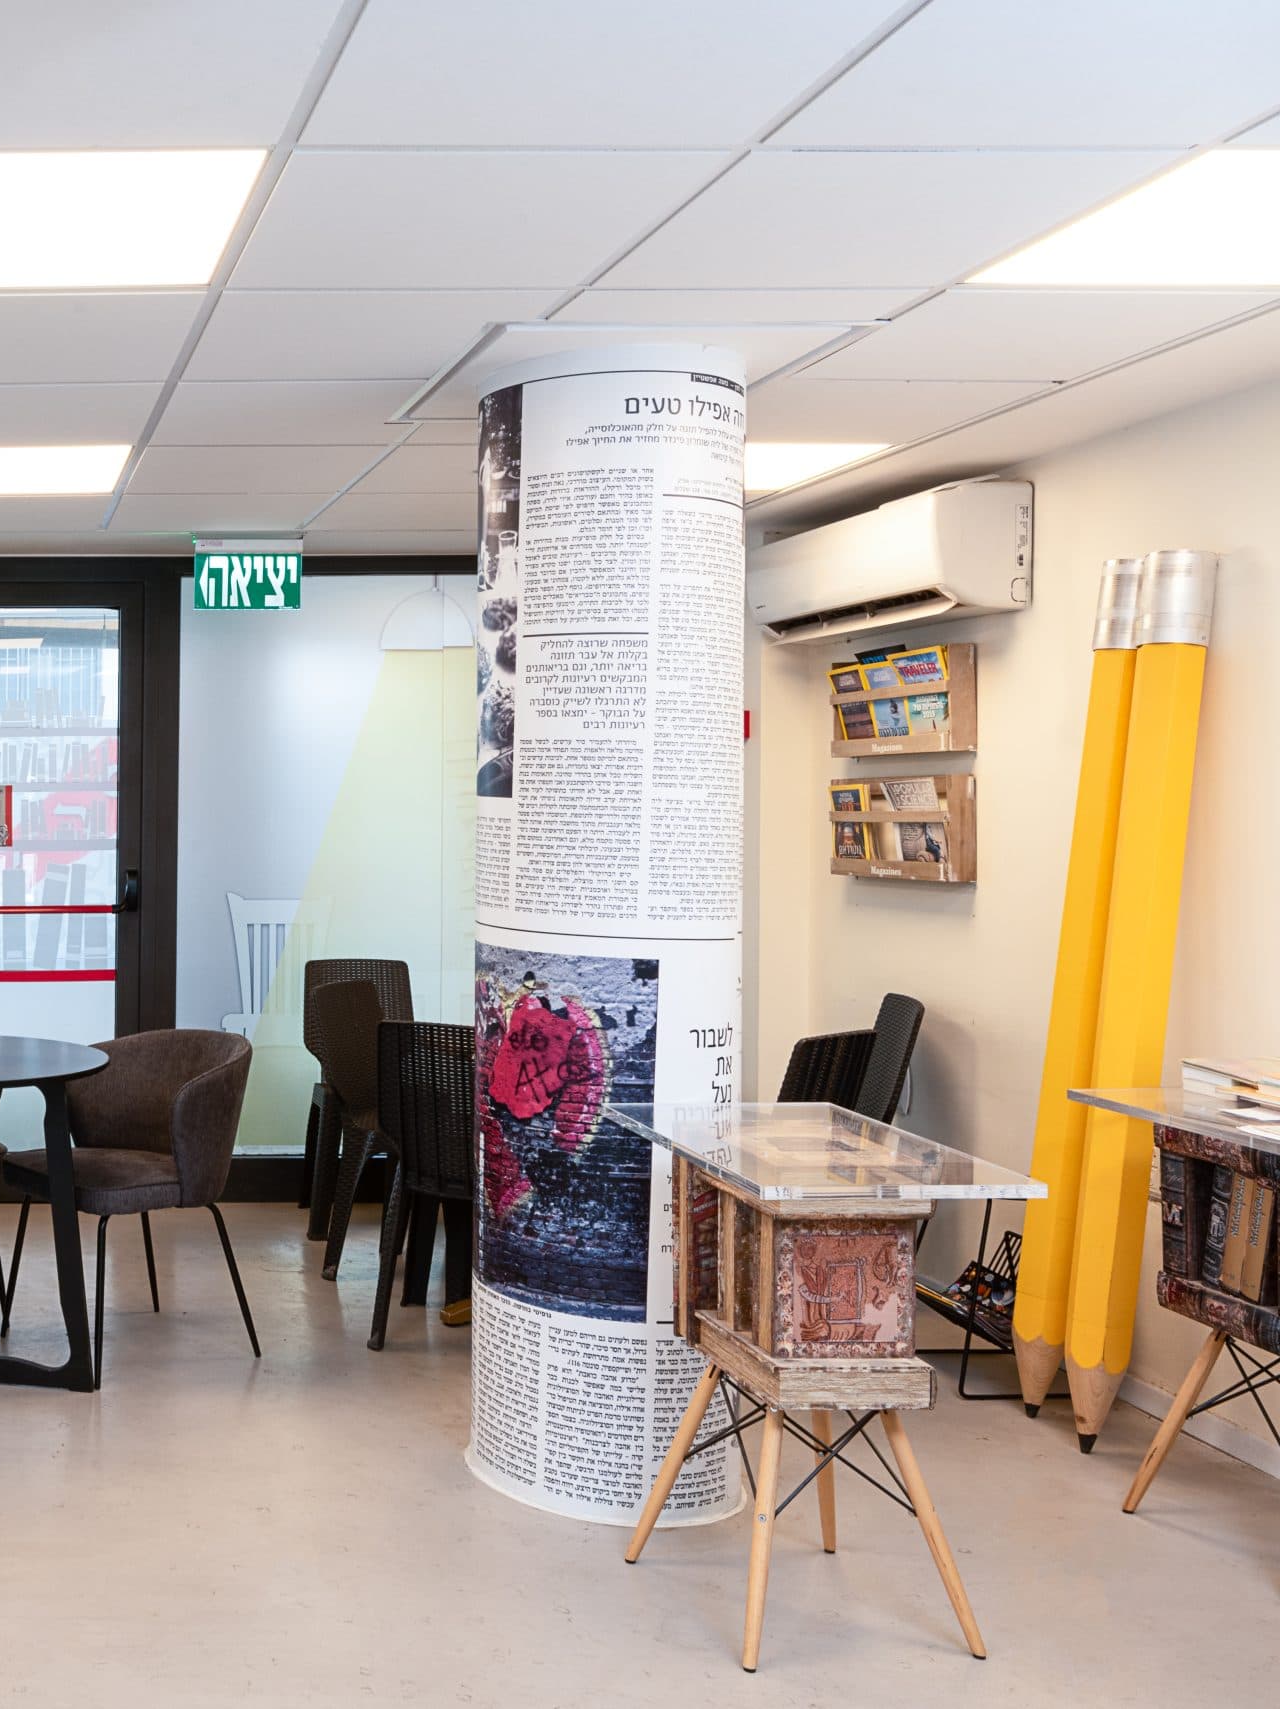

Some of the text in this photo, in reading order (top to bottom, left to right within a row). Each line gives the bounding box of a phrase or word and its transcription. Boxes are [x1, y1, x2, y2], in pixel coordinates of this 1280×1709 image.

[625, 397, 682, 414] טעים
[688, 395, 730, 423] אפילו
[646, 424, 664, 434] חלק
[566, 437, 590, 446] אפילו
[592, 436, 616, 446] החיוך
[618, 436, 632, 444] את
[635, 434, 660, 444] מחזיר
[208, 556, 298, 607] יציאה
[540, 640, 574, 651] להחליק
[600, 650, 614, 659] אל
[618, 650, 648, 661] בקלות
[572, 663, 586, 671] וגם
[590, 662, 614, 672] יותר,
[617, 662, 646, 671] בריאה
[898, 662, 938, 677] TRAVELER
[526, 674, 646, 685] המבקשים רעיונות לקרובים
[542, 686, 646, 696] מדרגה ראשונה שעדיין
[530, 696, 646, 708] לא התרגלו לשייק כוסברה
[536, 710, 558, 718] בספר
[561, 709, 587, 718] ימצאו
[600, 709, 630, 719] הבוקר
[634, 708, 646, 718] על
[584, 720, 645, 729] רעיונות רבים
[872, 744, 903, 752] Magazines
[871, 866, 902, 876] Magazines
[690, 1022, 732, 1048] לשבור
[716, 1056, 732, 1076] את
[712, 1081, 732, 1104] נעל
